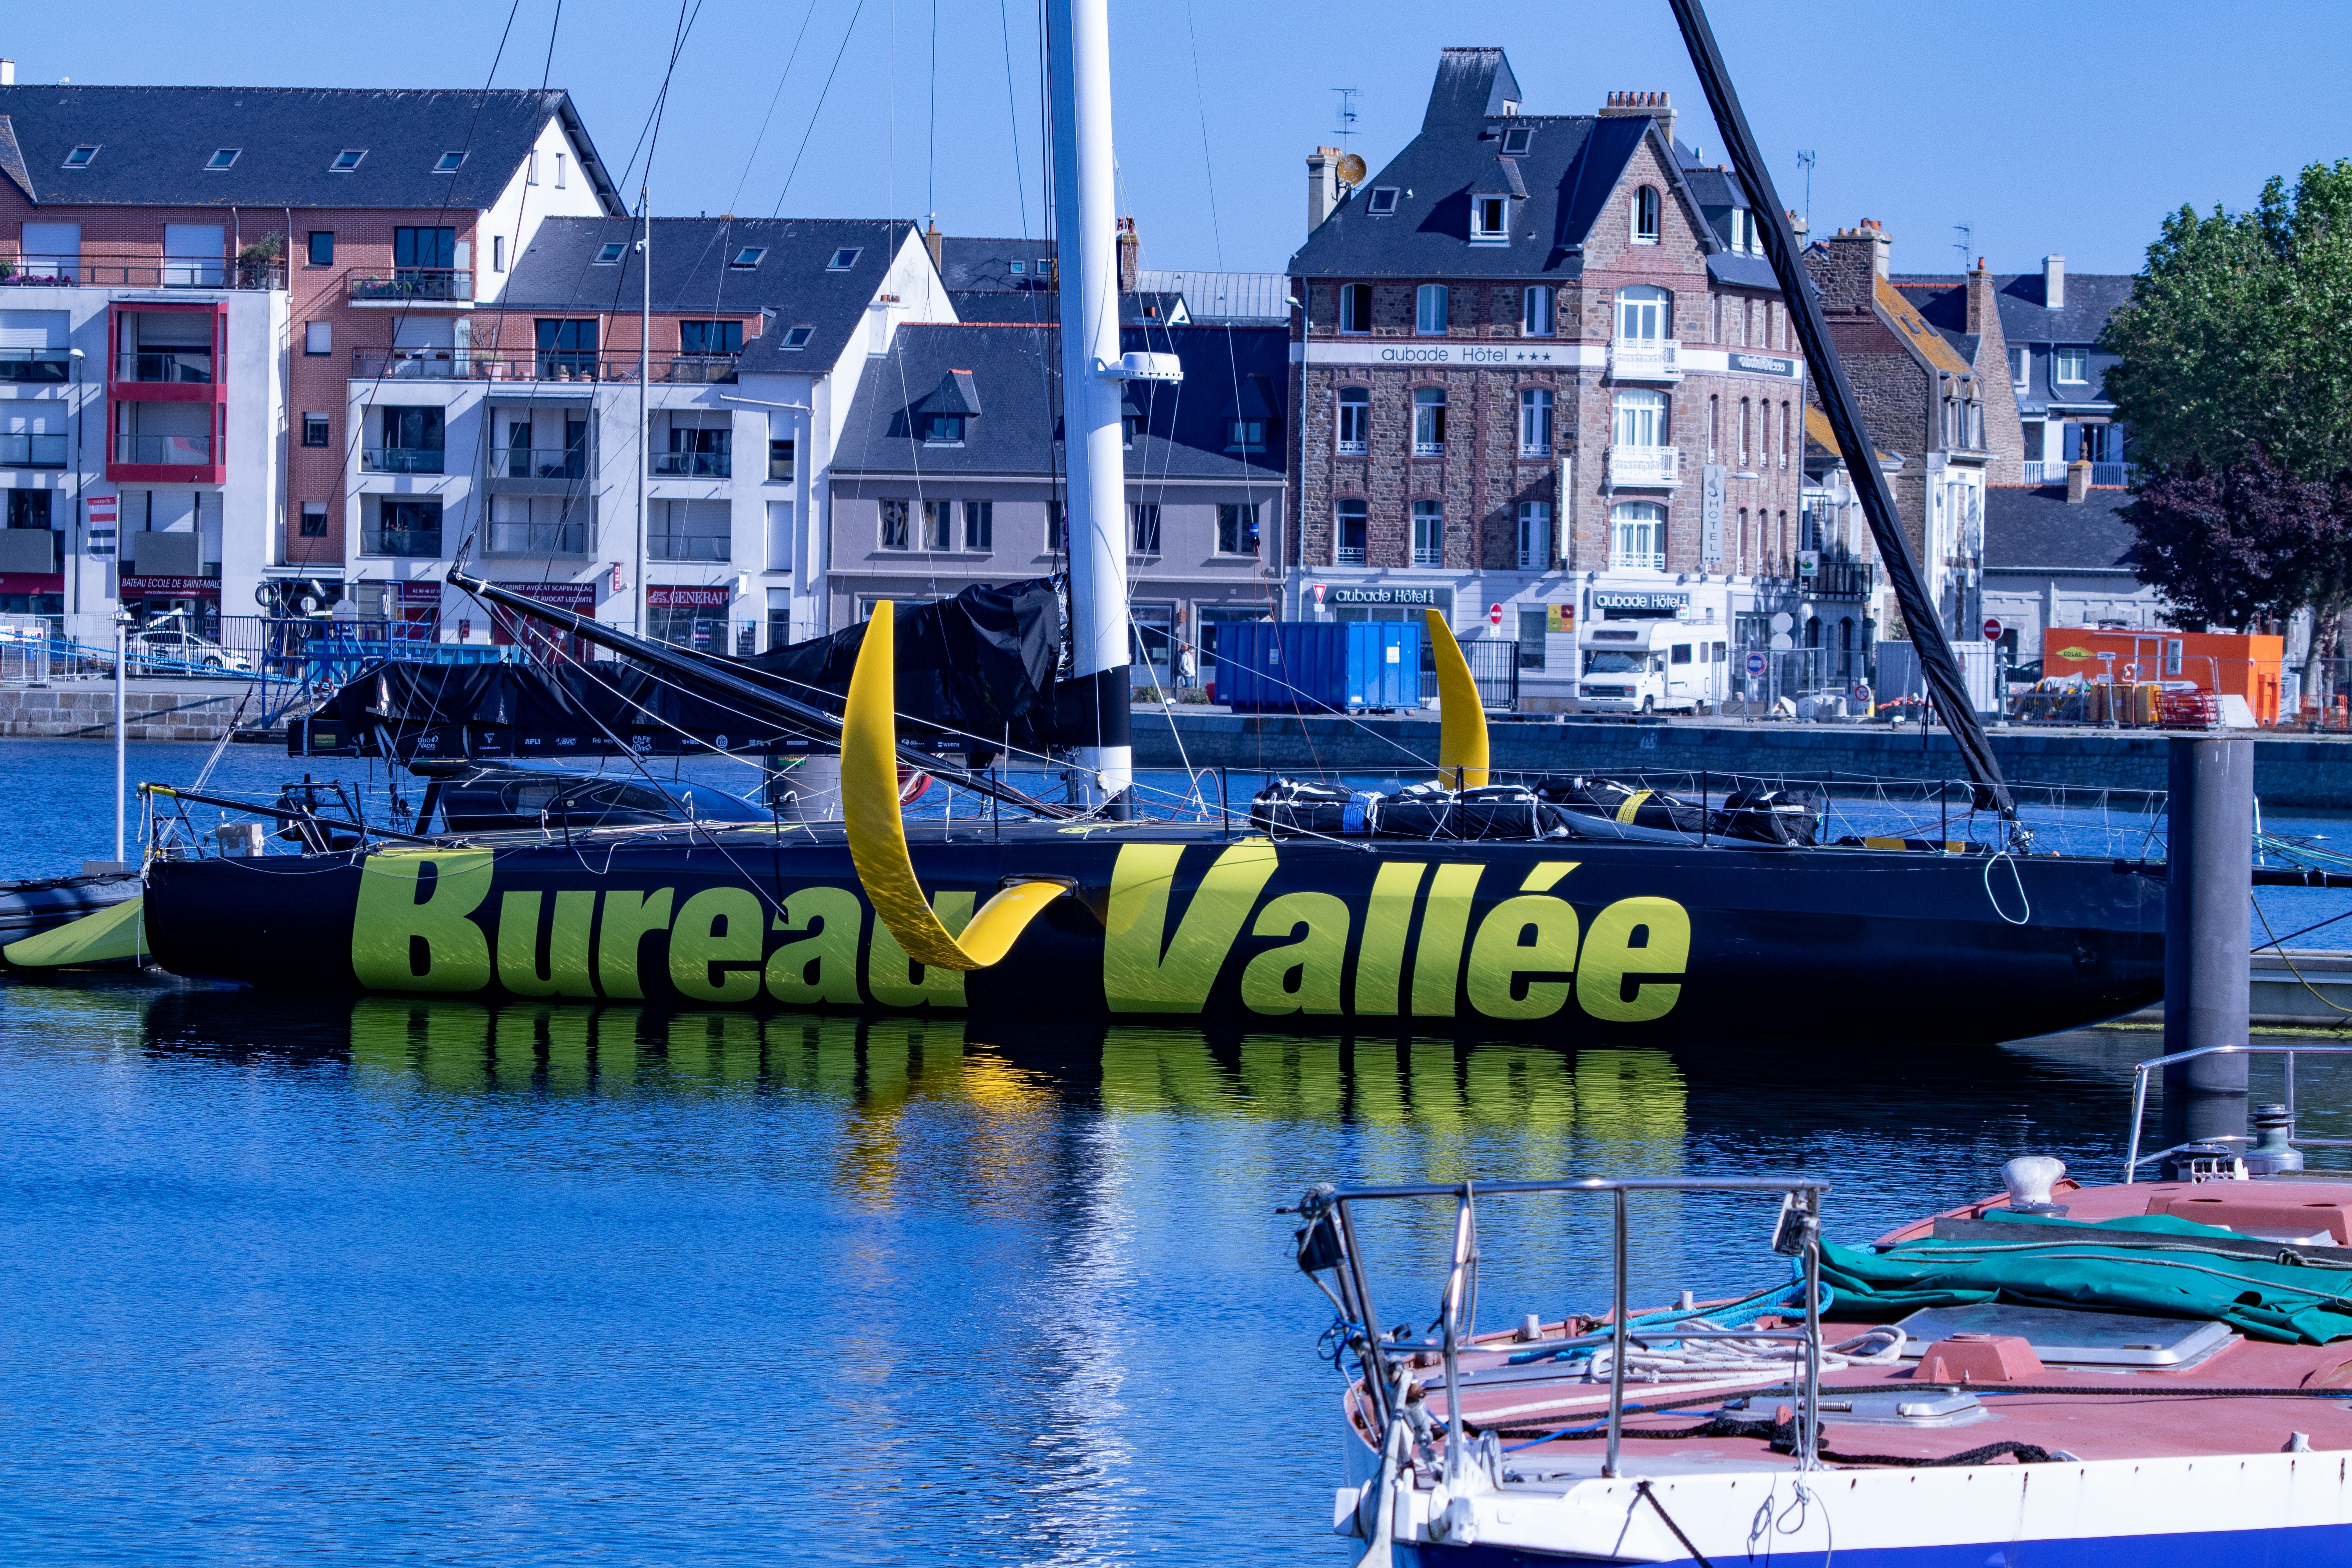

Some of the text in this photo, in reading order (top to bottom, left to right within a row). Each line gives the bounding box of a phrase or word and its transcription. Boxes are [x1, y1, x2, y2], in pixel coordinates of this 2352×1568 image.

[1382, 347, 1507, 361] aubade Hôtel
[1709, 500, 1719, 552] HOTEL
[122, 578, 146, 587] BATEAU
[148, 577, 170, 588] ÉCOLE
[172, 579, 181, 588] DE
[1336, 589, 1426, 603] aubade Hôtel
[1597, 593, 1680, 608] aubade Hôtel
[633, 735, 651, 744] CAFÉ
[351, 837, 1690, 1022] Bureau Vallée
